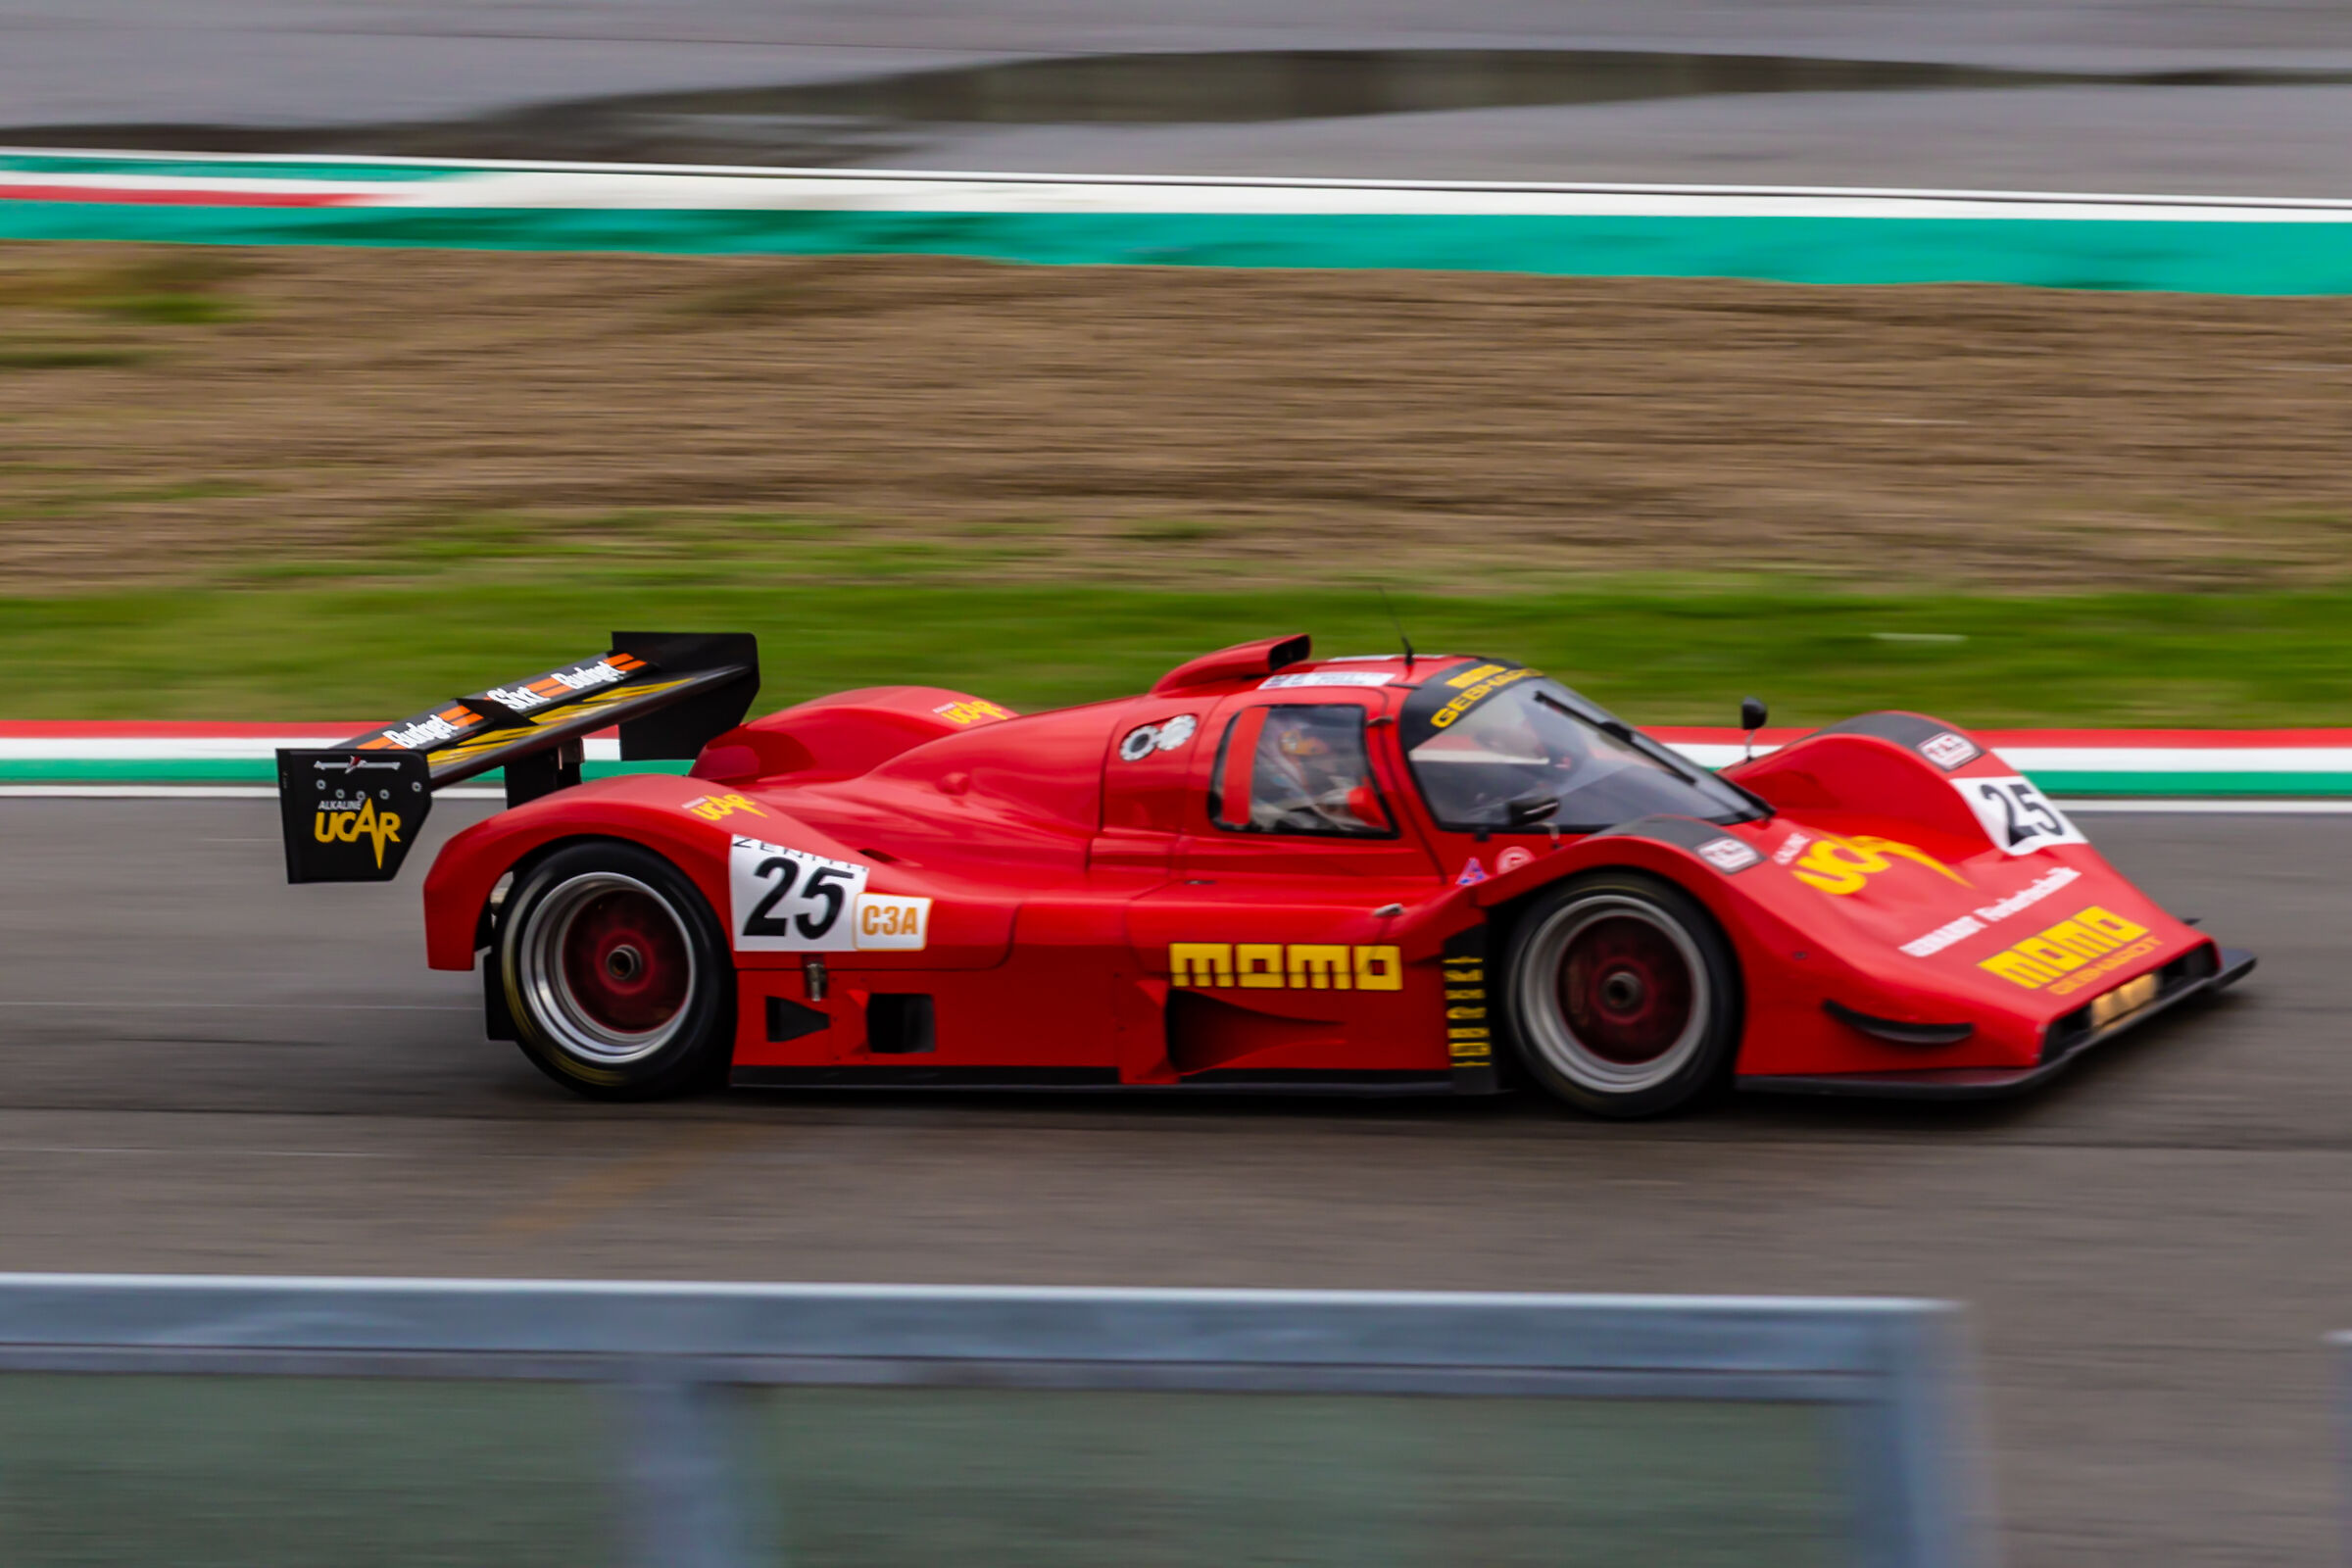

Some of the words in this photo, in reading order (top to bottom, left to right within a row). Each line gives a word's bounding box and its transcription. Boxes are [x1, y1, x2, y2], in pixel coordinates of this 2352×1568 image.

[383, 714, 459, 749] Budget
[486, 687, 551, 710] Sixt
[551, 661, 626, 690] Budget
[314, 797, 402, 869] UCAR
[318, 800, 362, 810] ALKALINE
[1980, 784, 2065, 848] 25
[742, 857, 855, 940] 25
[861, 905, 918, 936] C3A
